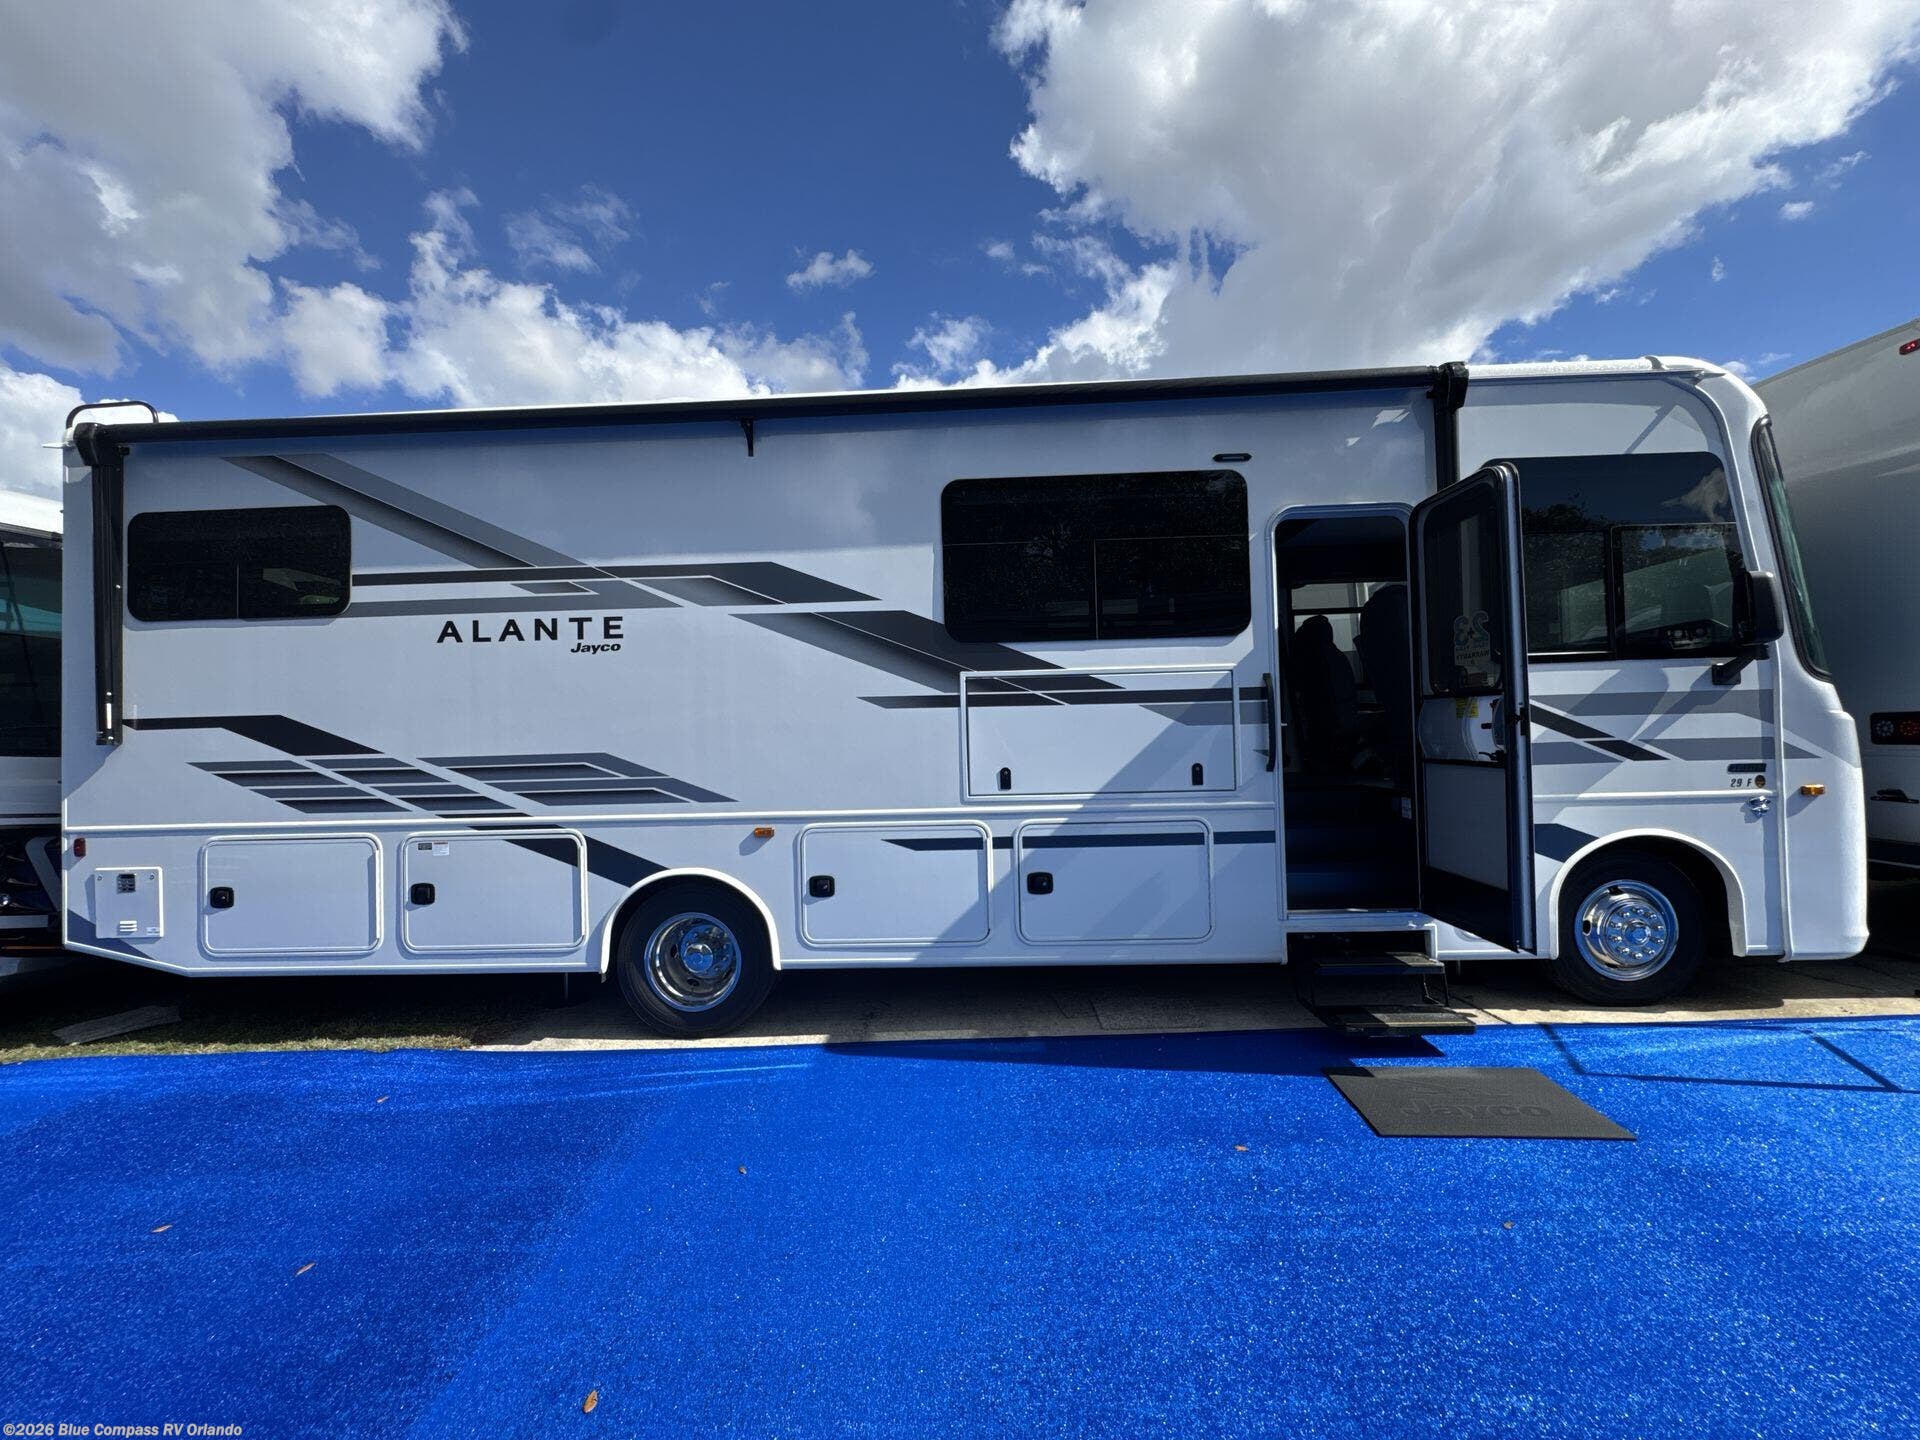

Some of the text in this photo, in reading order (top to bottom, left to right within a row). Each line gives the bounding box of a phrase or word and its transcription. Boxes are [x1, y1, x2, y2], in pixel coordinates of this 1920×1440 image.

[437, 616, 624, 644] ALANTE
[570, 642, 622, 655] Jayco
[1730, 778, 1752, 788] 29 F
[1404, 1100, 1551, 1120] Jayco
